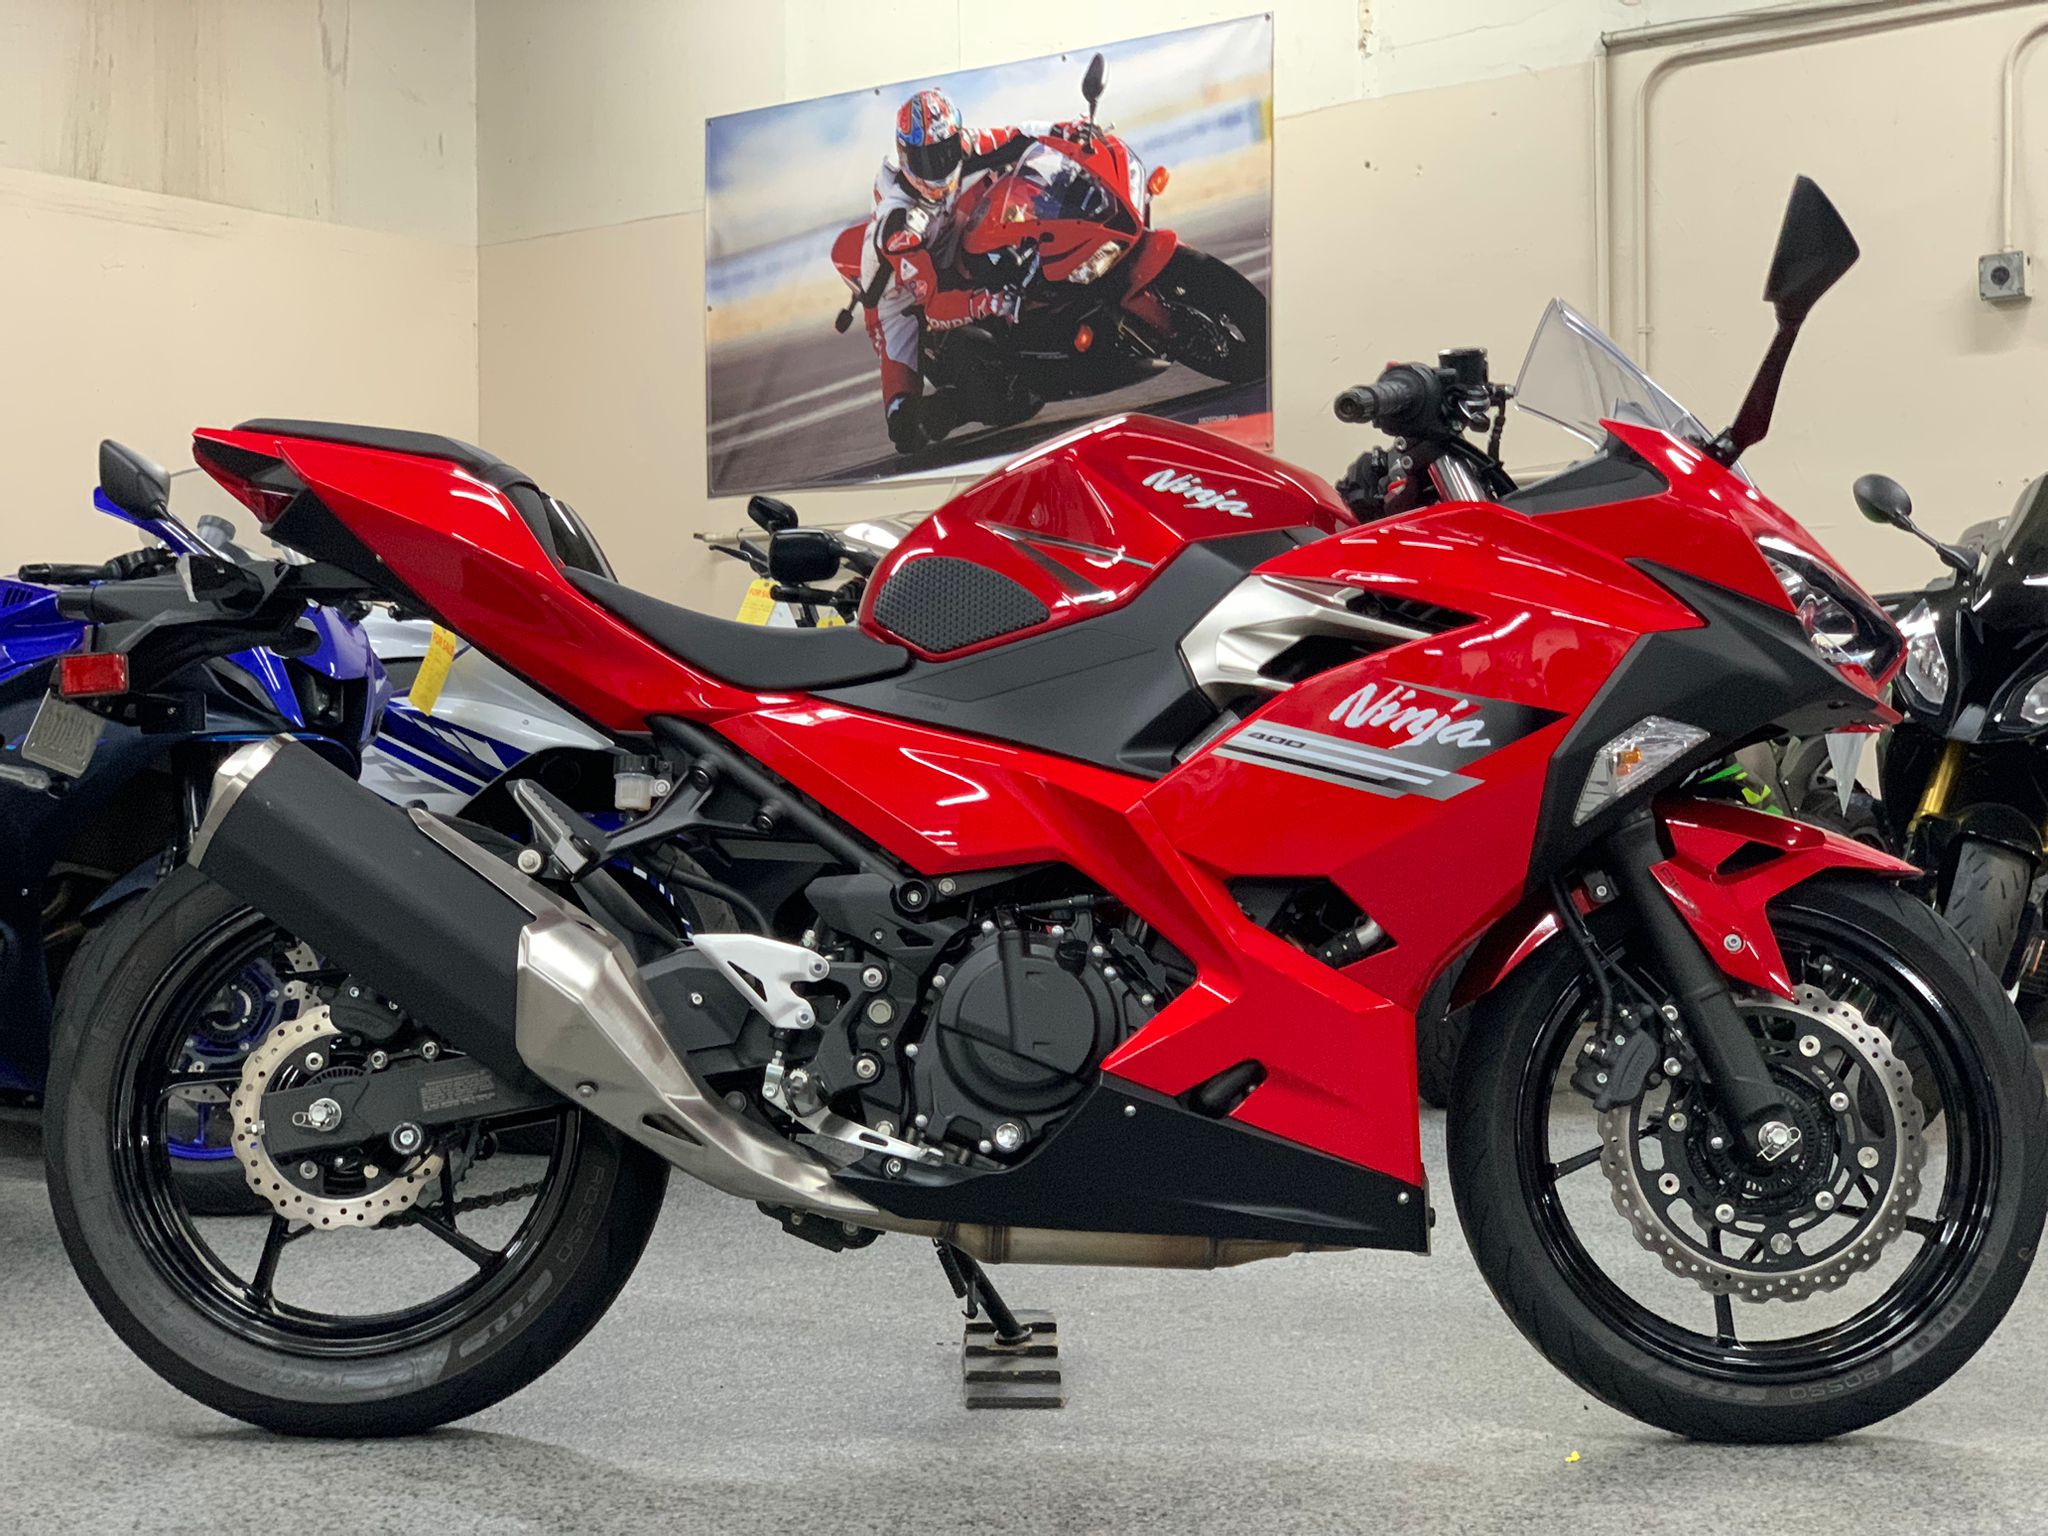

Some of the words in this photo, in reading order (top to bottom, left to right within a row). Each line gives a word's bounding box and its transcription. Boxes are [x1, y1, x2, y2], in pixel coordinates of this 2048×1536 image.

[1142, 468, 1252, 518] Ninja
[1248, 732, 1307, 748] 400
[1329, 682, 1491, 750] Ninja
[556, 1166, 606, 1263] ROSSO
[1789, 1366, 1881, 1400] ROSSO
